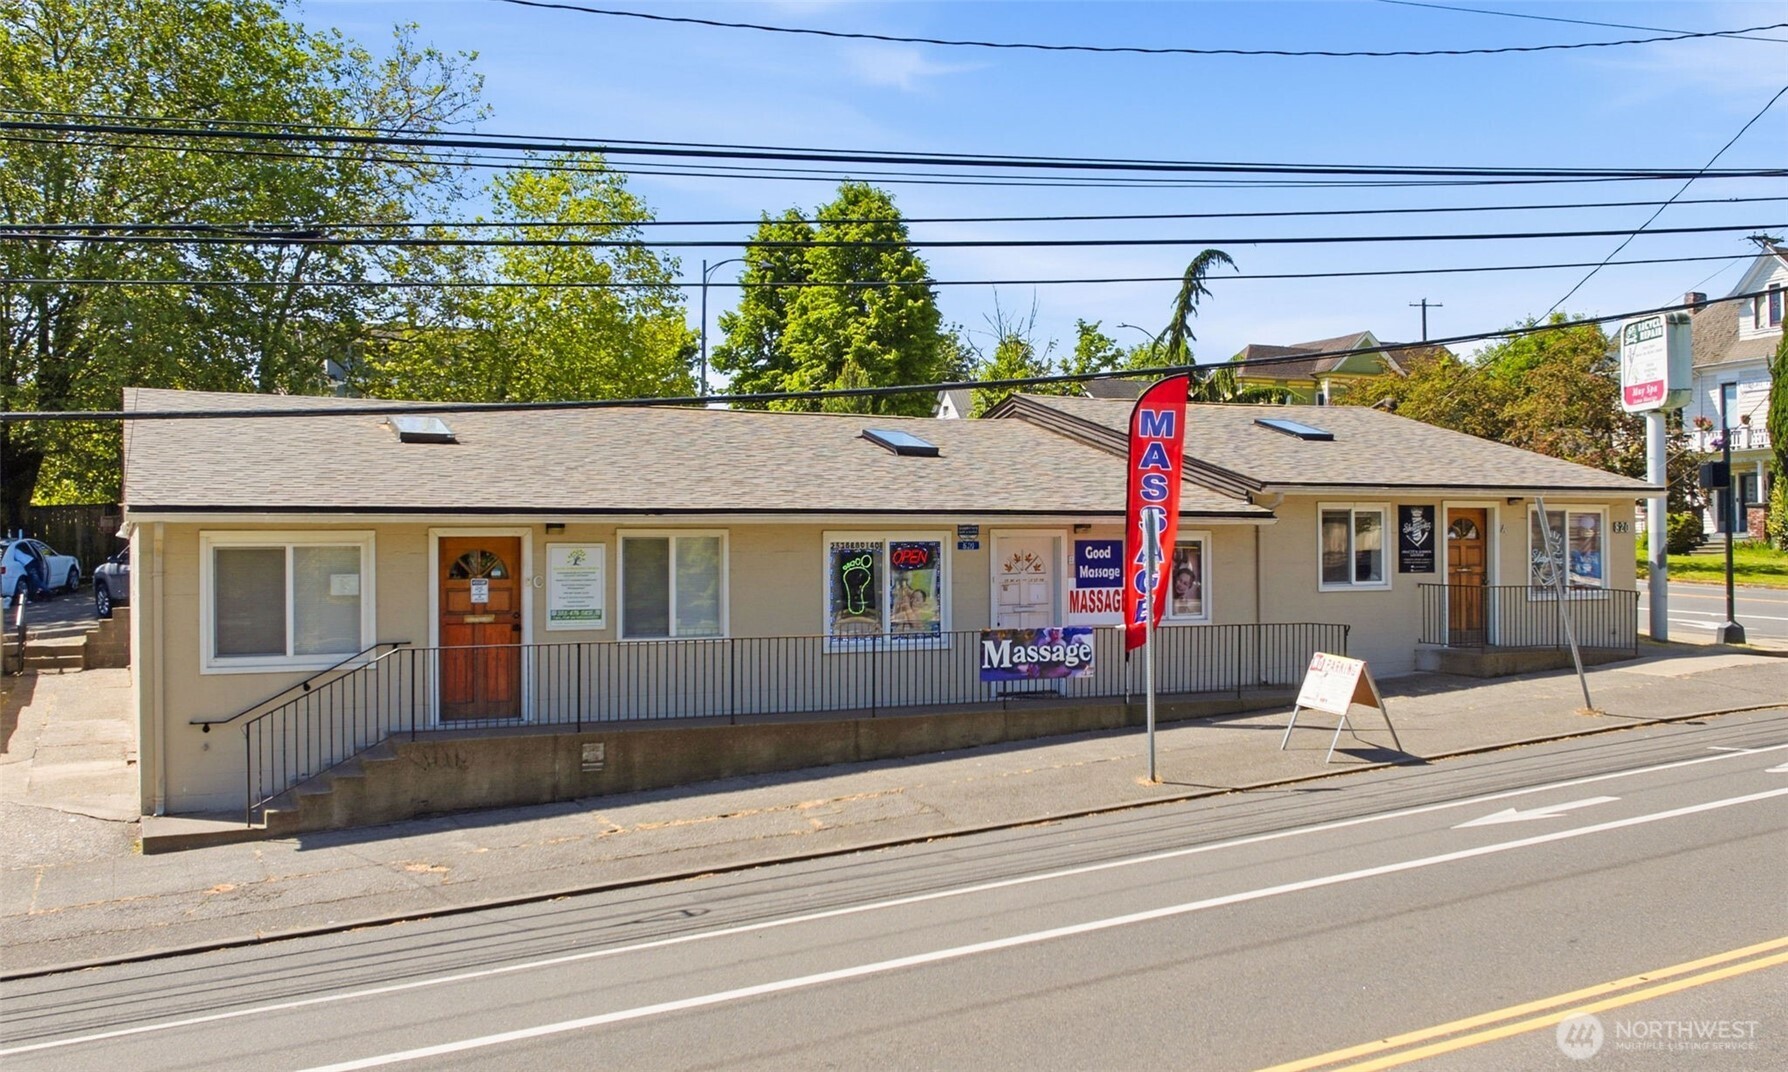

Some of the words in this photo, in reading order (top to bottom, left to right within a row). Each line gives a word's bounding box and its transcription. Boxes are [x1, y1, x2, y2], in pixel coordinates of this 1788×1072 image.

[1646, 384, 1658, 396] Spa
[892, 549, 928, 567] OPEN
[1085, 545, 1111, 559] Good
[1079, 565, 1120, 580] Massage
[981, 640, 1092, 669] Massage
